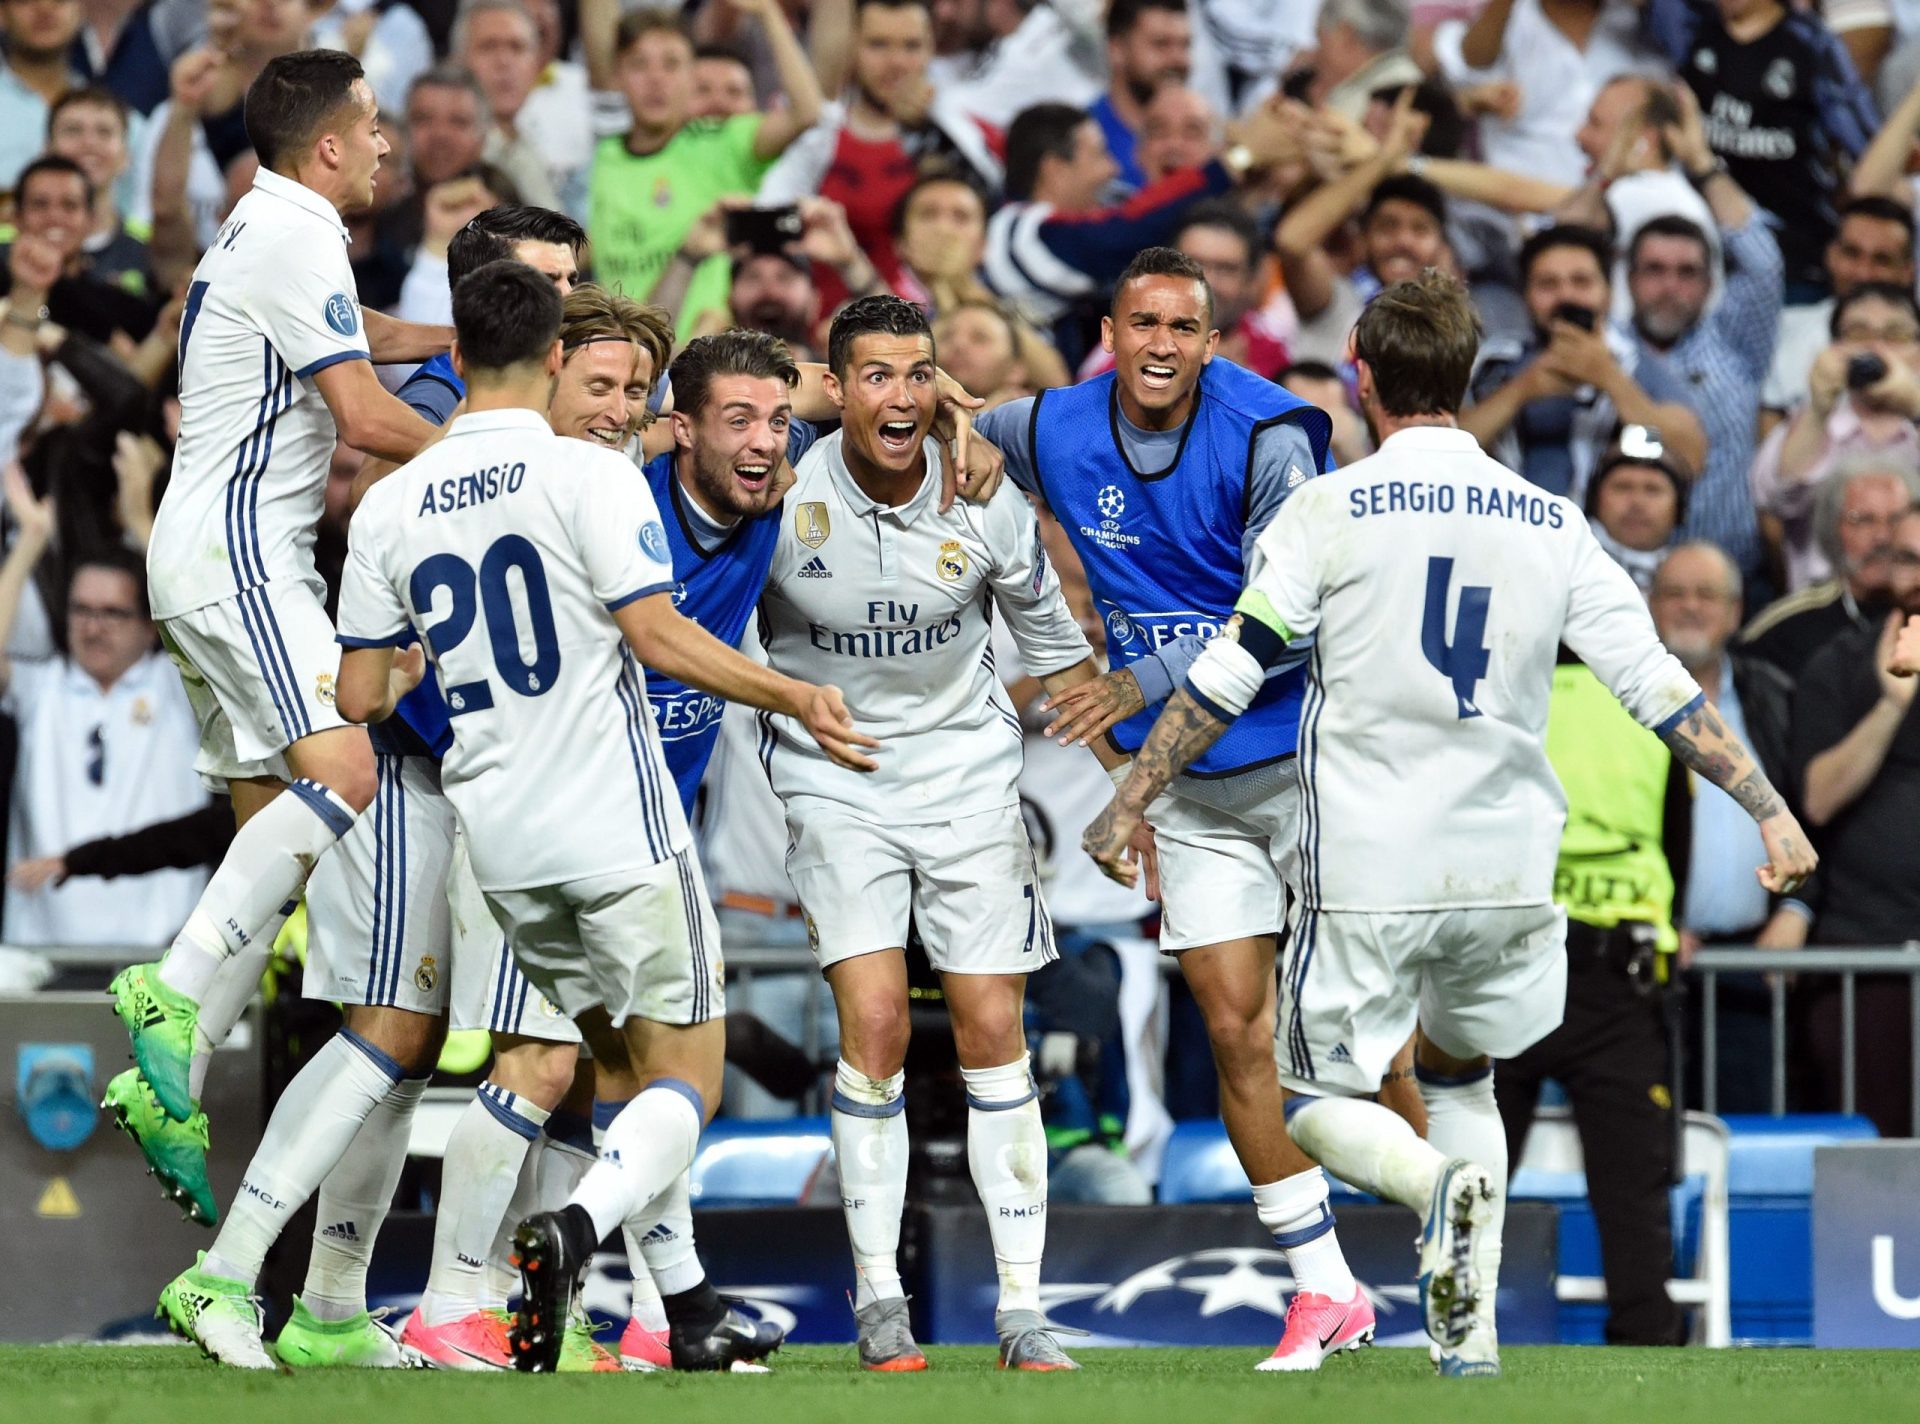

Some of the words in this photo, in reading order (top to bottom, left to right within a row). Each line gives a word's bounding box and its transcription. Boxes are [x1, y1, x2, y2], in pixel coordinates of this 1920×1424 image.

[1466, 485, 1564, 529] RAMOS
[1080, 526, 1141, 545] CHAMPIONS
[1096, 537, 1128, 550] LEAGUE
[797, 569, 833, 579] adidas
[409, 533, 562, 718] 20
[867, 600, 919, 627] Fly
[808, 609, 962, 658] Emirates
[1421, 555, 1493, 720] 4
[1022, 883, 1036, 953] 7
[240, 1179, 288, 1210] RMCF
[322, 1228, 360, 1242] adidas
[640, 1232, 680, 1247] adidas
